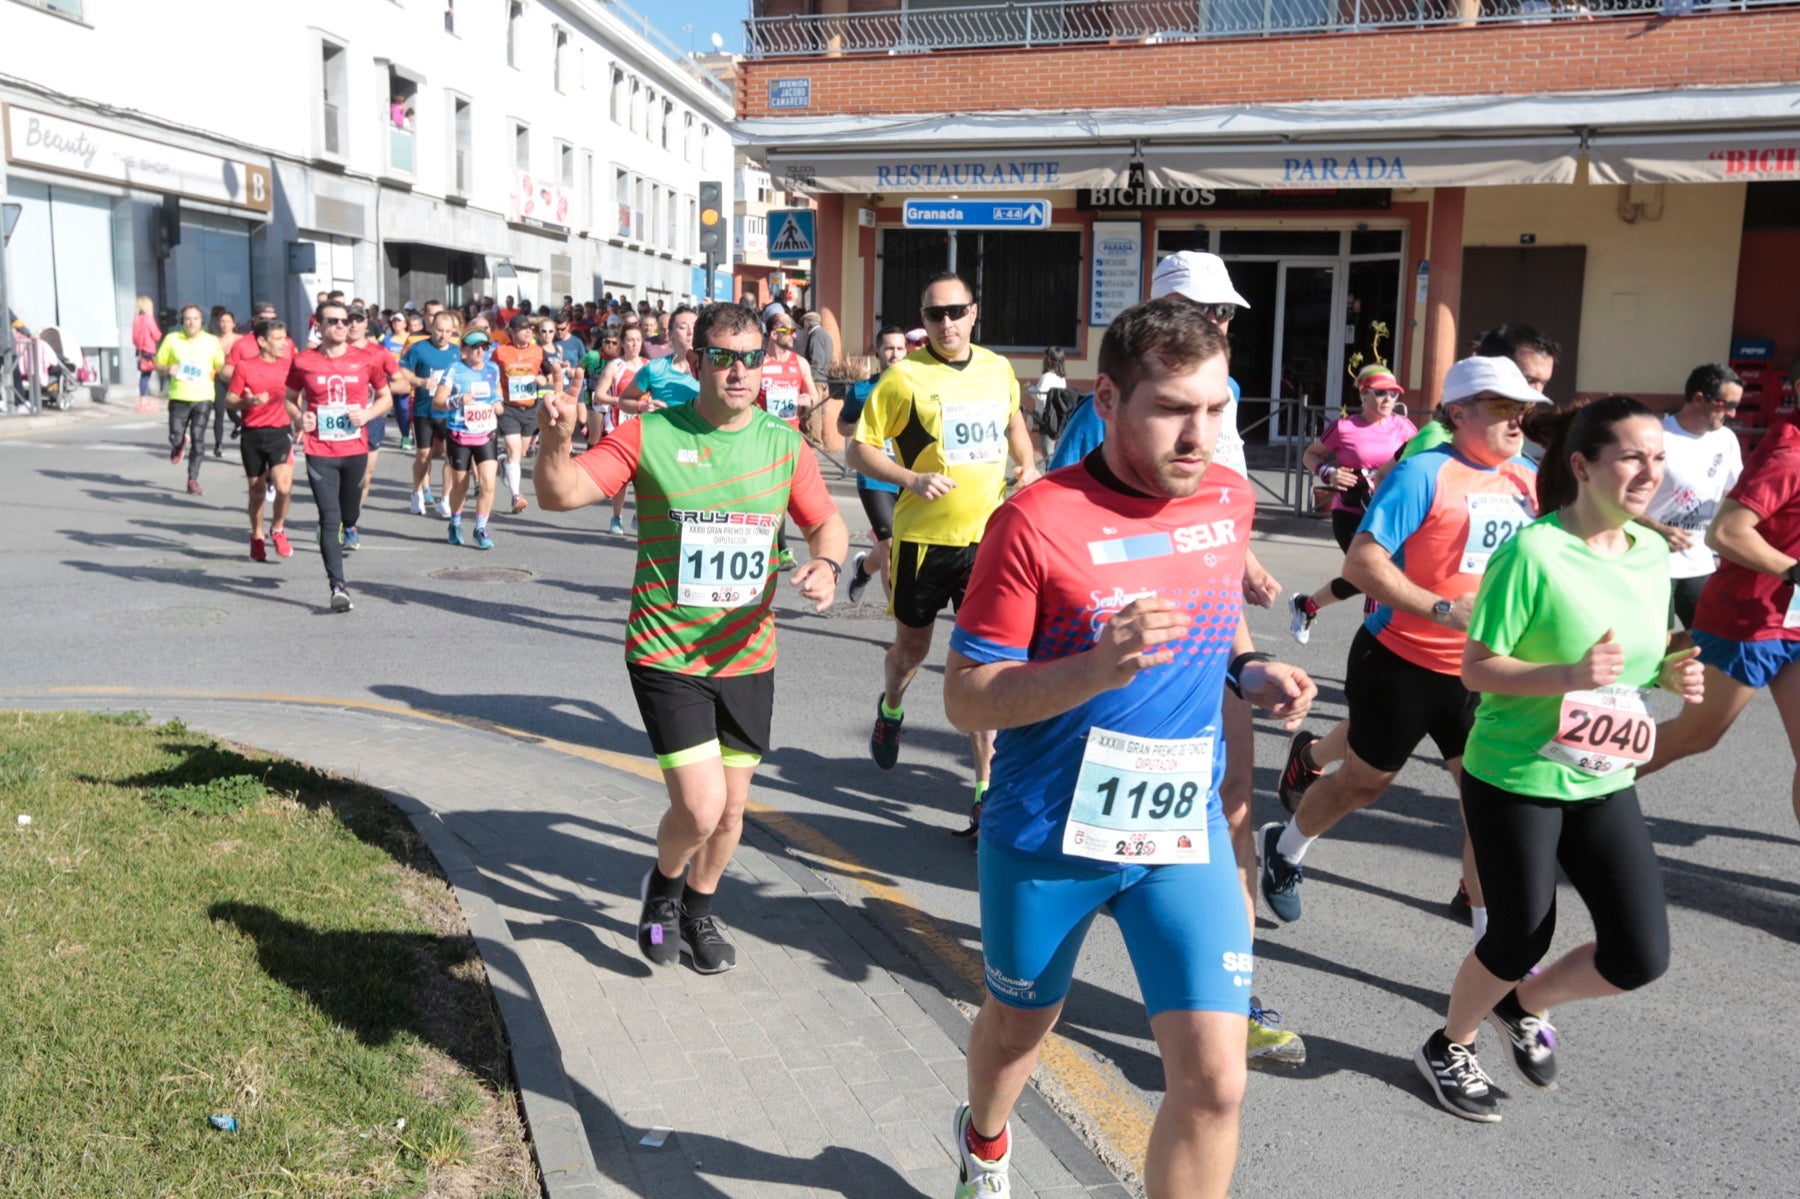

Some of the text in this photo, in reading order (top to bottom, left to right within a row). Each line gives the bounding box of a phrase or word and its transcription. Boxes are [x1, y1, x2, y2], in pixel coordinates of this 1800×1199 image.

[26, 118, 97, 168] Beauty
[1283, 156, 1406, 181] PARADA
[1708, 147, 1800, 174] “BICH
[876, 162, 1060, 187] RESTAURANTE
[1090, 187, 1216, 206] BICHITOS
[907, 207, 964, 220] Granada
[466, 409, 493, 421] 2007
[772, 399, 795, 411] 716
[955, 420, 999, 444] 904
[1173, 519, 1237, 553] SEUR
[688, 550, 764, 580] 1103
[1562, 708, 1651, 754] 2040
[1127, 741, 1150, 755] GRAN
[1097, 776, 1198, 820] 1198
